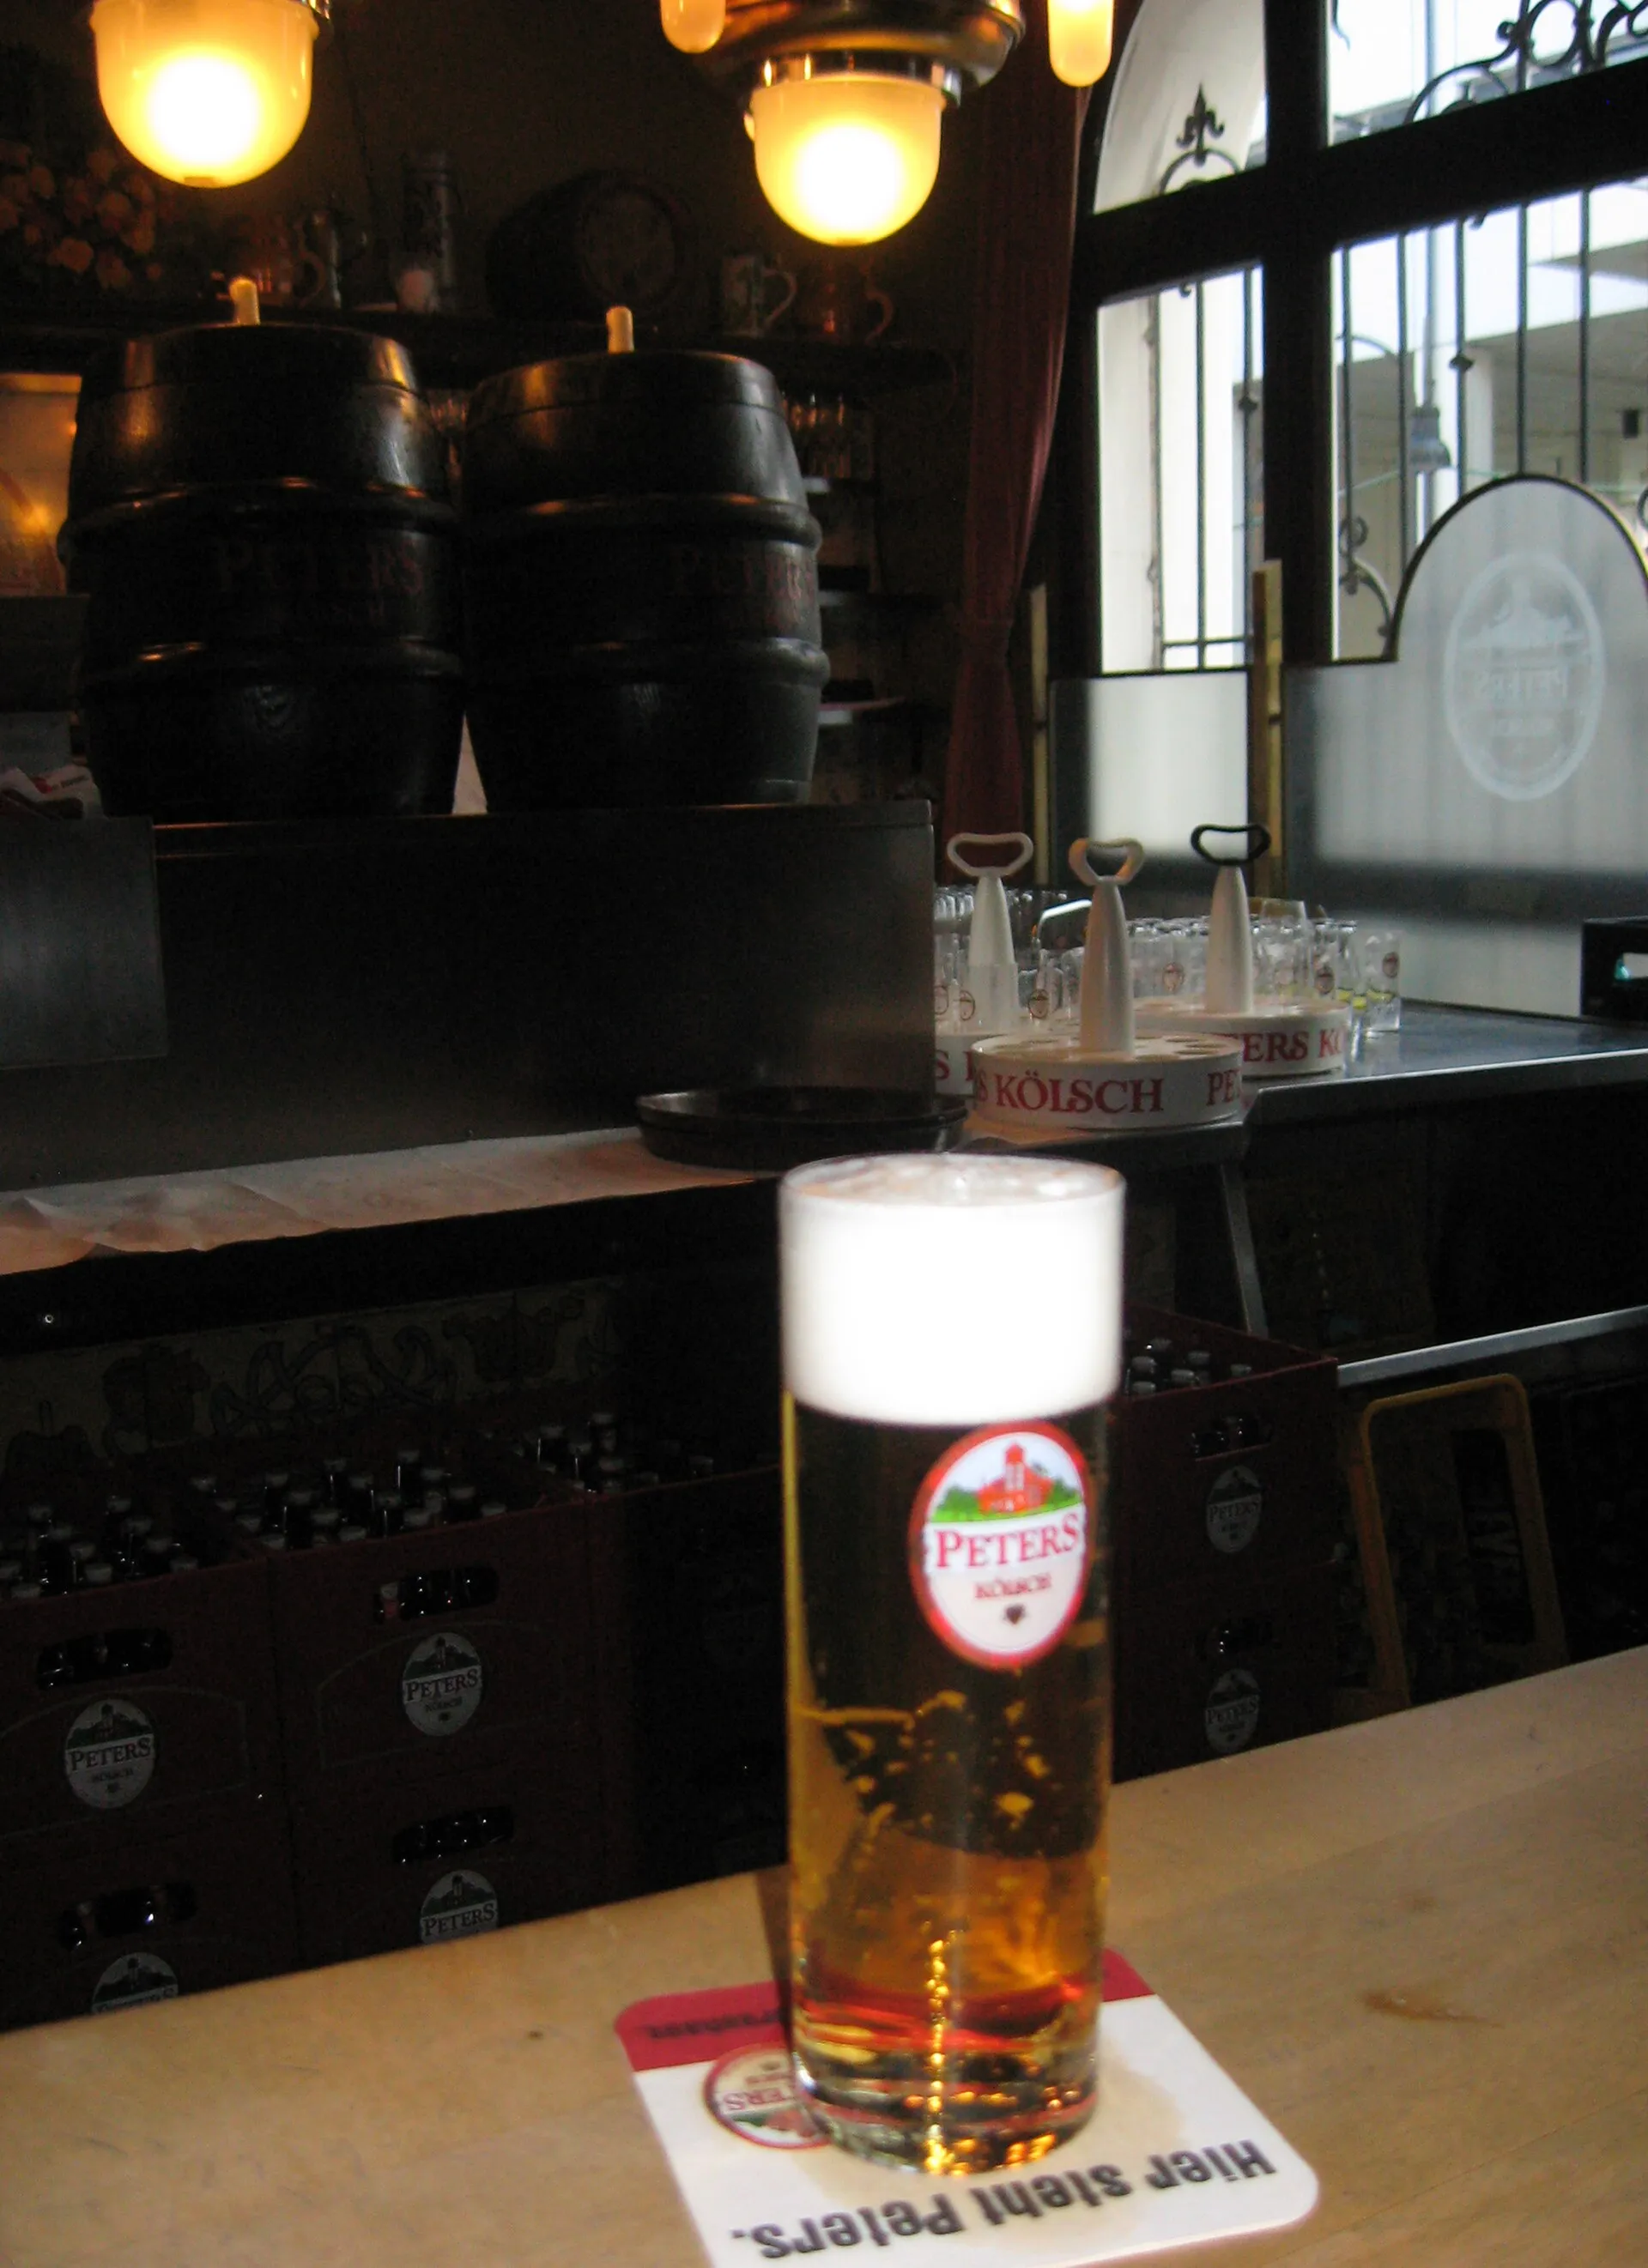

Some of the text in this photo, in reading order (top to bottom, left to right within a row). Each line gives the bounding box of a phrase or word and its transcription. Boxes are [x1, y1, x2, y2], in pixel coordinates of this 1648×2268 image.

[1221, 1029, 1309, 1062] ERS
[994, 1068, 1165, 1115] KÖLSCH
[934, 1512, 1079, 1568] PETERS
[406, 1668, 479, 1702] PETERS
[69, 1737, 151, 1771] PETERS
[422, 1903, 496, 1937] PETERS
[730, 2139, 1276, 2262] Hier steht Peters.
